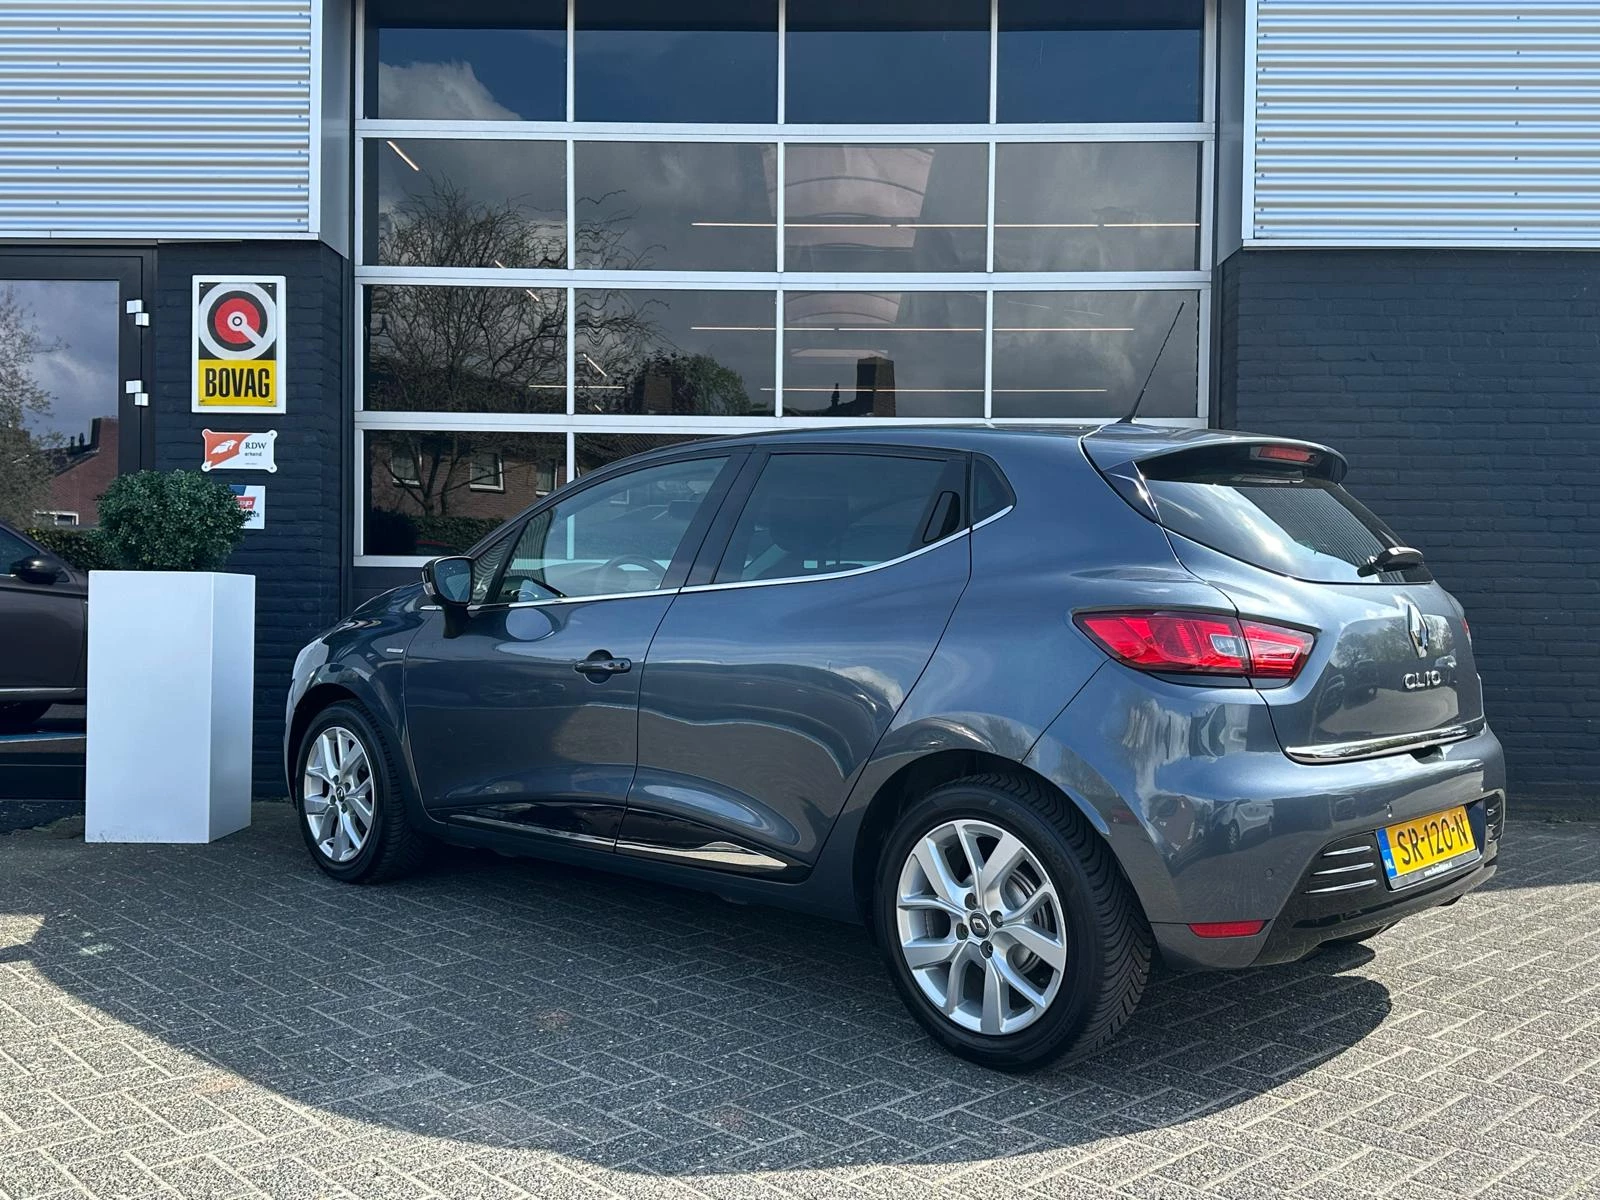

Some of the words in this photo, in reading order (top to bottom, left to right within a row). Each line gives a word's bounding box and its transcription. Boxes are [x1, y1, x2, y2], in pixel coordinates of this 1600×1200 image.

[205, 367, 270, 398] BOVAG
[244, 441, 267, 450] RDW
[1403, 670, 1441, 690] CLIO
[1396, 812, 1469, 865] SR-120-N
